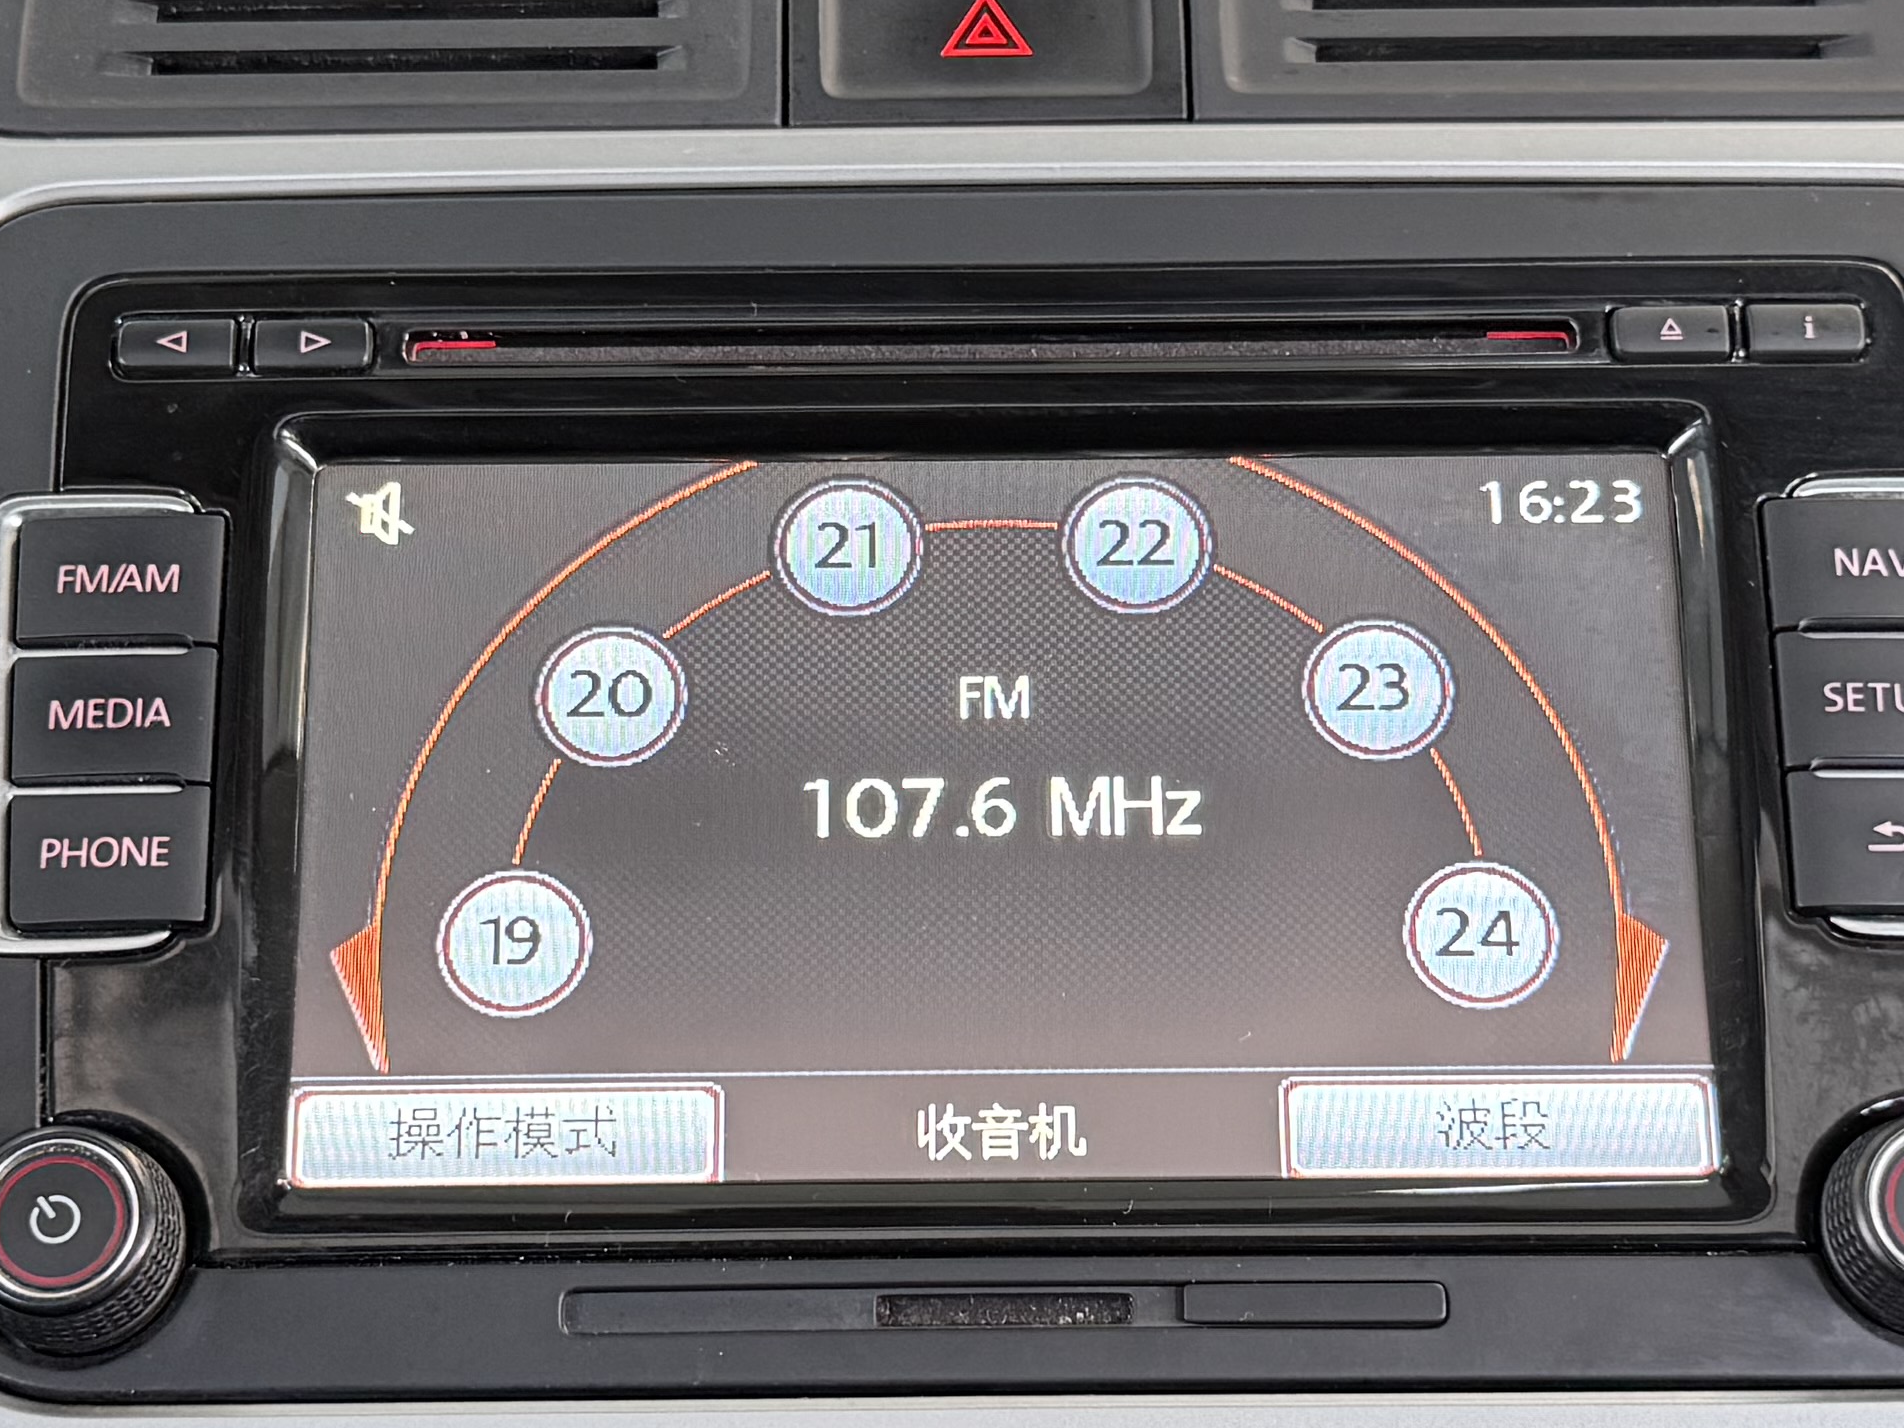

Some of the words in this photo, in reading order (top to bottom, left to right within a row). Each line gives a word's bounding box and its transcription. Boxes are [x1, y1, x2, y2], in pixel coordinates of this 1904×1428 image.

[1478, 479, 1643, 525] 16:23
[815, 520, 882, 570] 21
[1096, 518, 1175, 567] 22
[55, 560, 181, 595] FM/AM
[565, 671, 654, 719] 20
[957, 675, 1031, 721] FM
[1336, 661, 1412, 712] 23
[47, 696, 173, 731] MEDIA
[802, 775, 1017, 839] 107.6
[1049, 775, 1204, 838] MHz
[38, 834, 171, 869] PHONE
[479, 916, 542, 967] 19
[1433, 908, 1520, 958] 24
[388, 1105, 619, 1161] 操作模式
[914, 1102, 1088, 1160] 收音机
[1437, 1098, 1552, 1153] 波段
